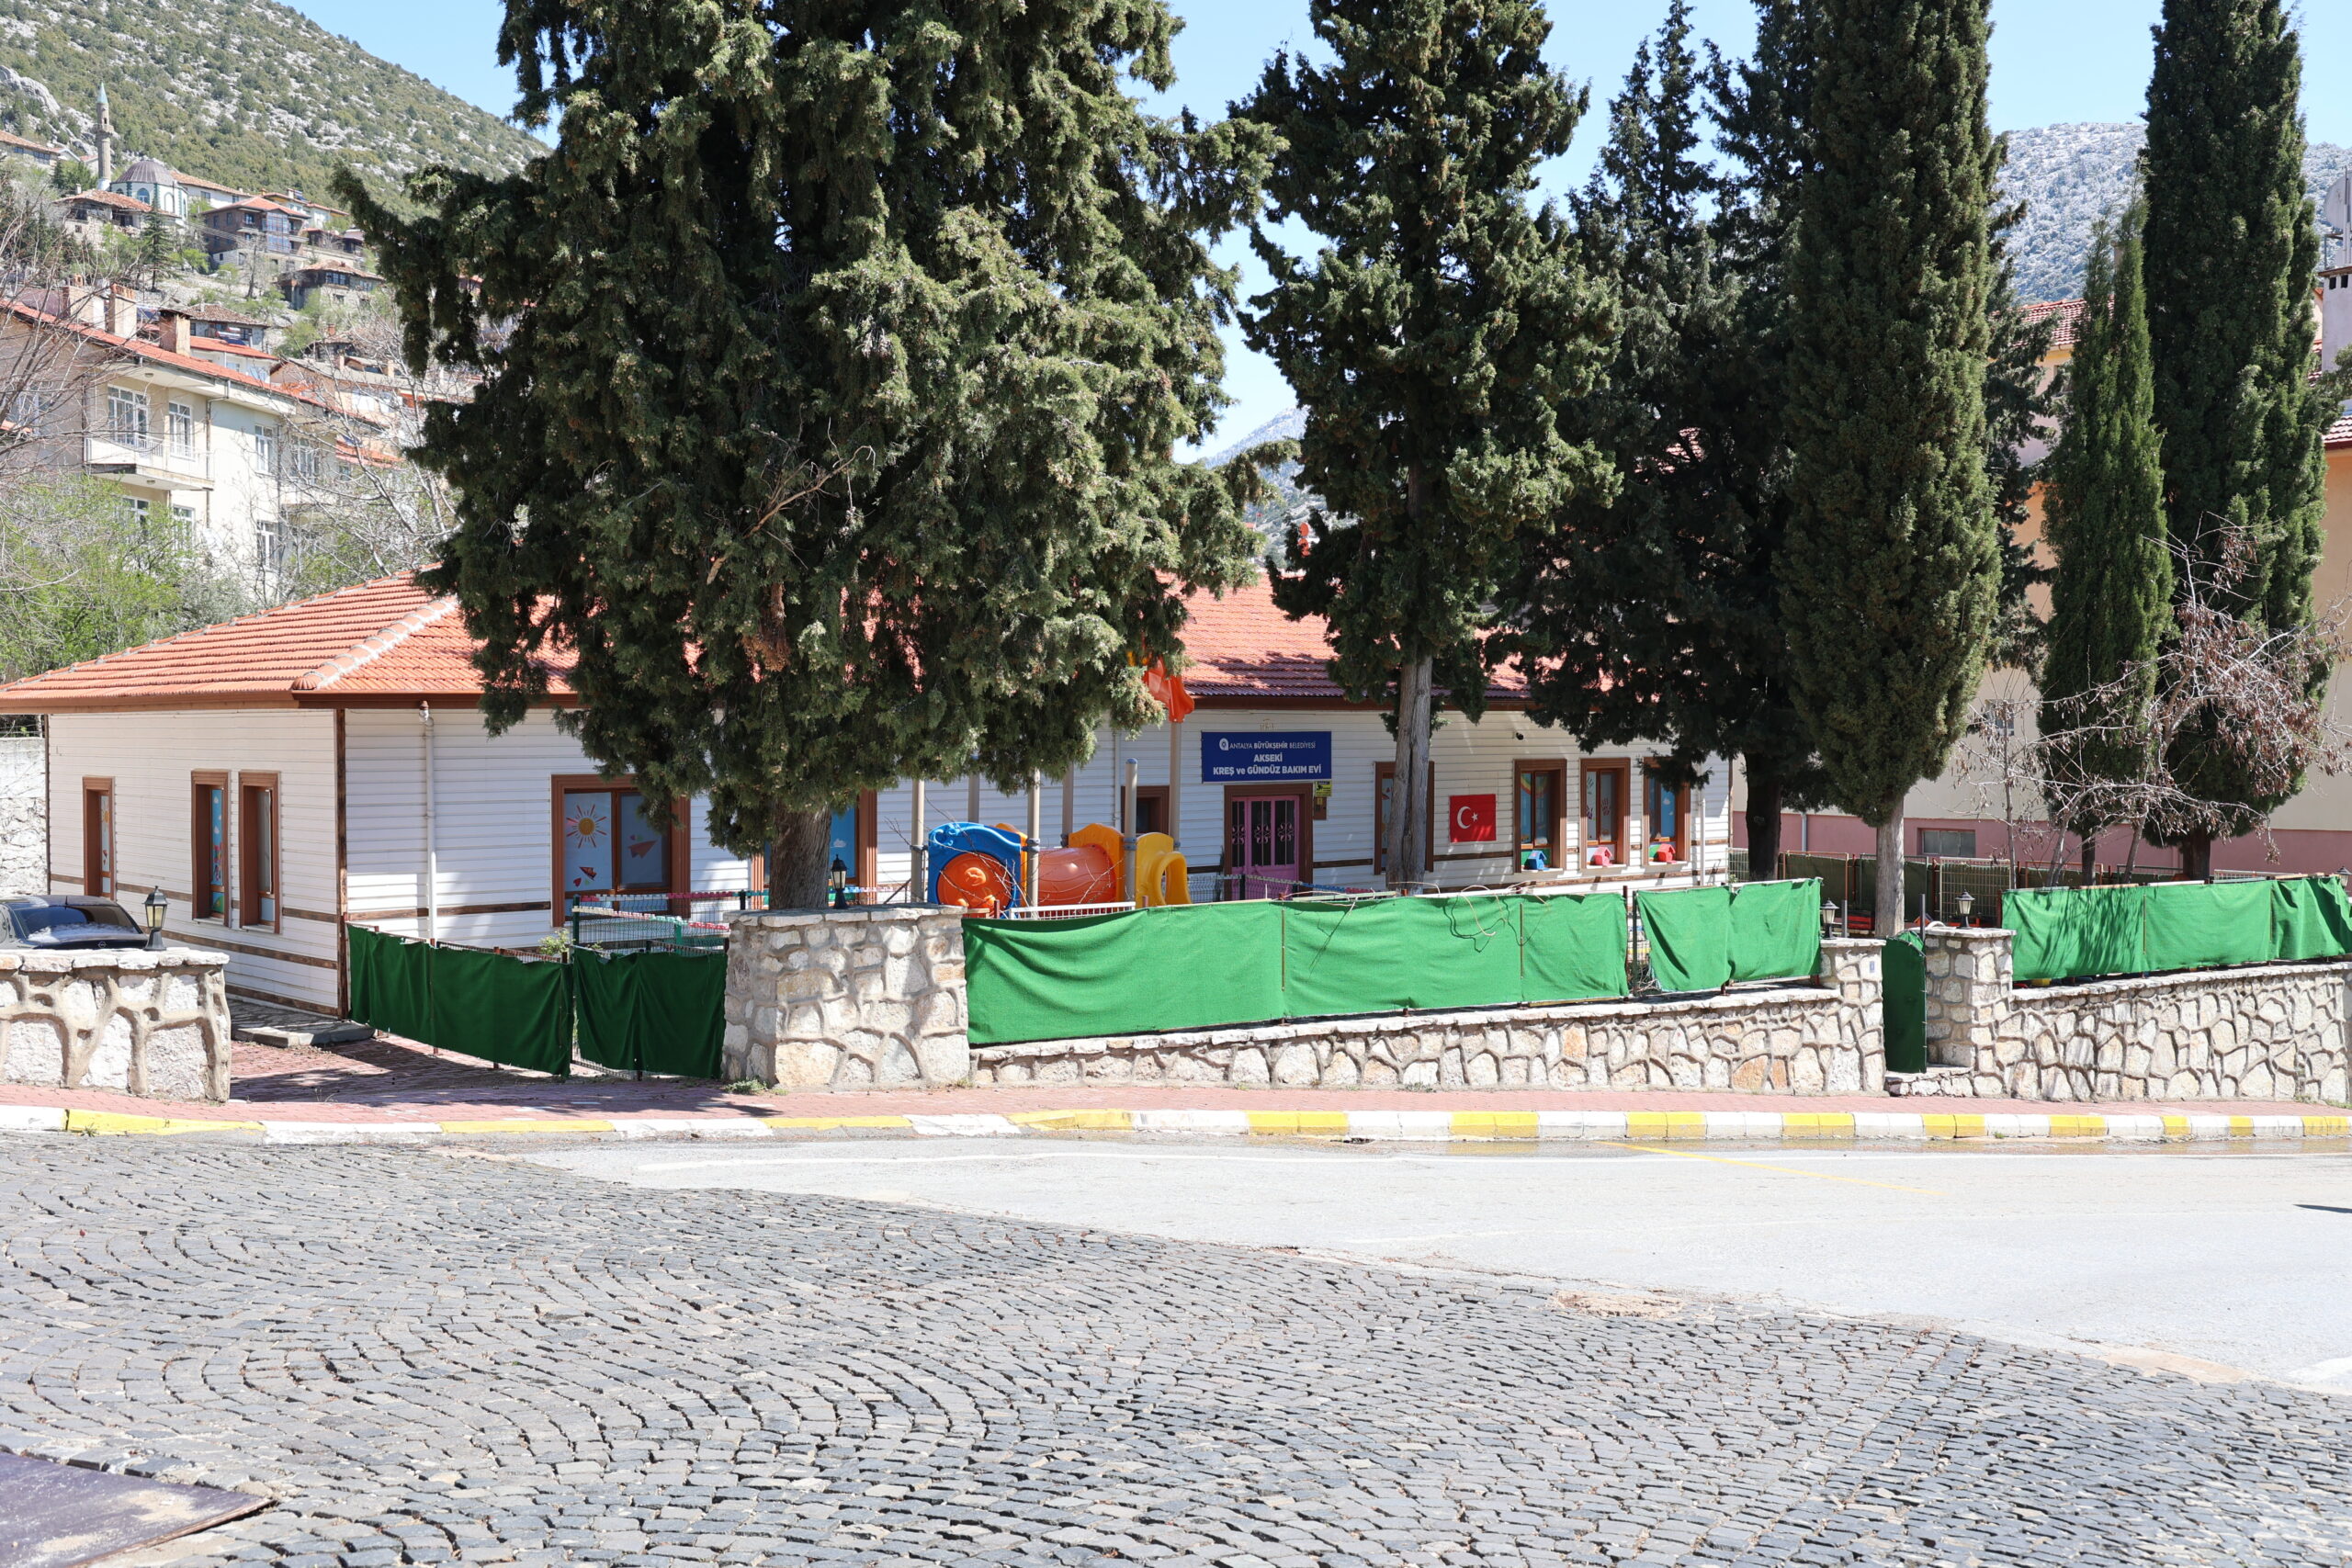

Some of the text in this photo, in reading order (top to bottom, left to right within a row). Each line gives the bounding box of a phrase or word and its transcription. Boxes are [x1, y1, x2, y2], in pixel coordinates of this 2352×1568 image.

[1253, 740, 1288, 750] BÜYÜKŞEHİR
[1289, 740, 1316, 749] BELEDİYESİ
[1253, 752, 1283, 762] AKSEKİ
[1213, 766, 1235, 776] KREŞ
[1247, 764, 1281, 774] GÜNDÜZ
[1282, 765, 1307, 773] BAKIM
[1308, 763, 1322, 773] EVİ
